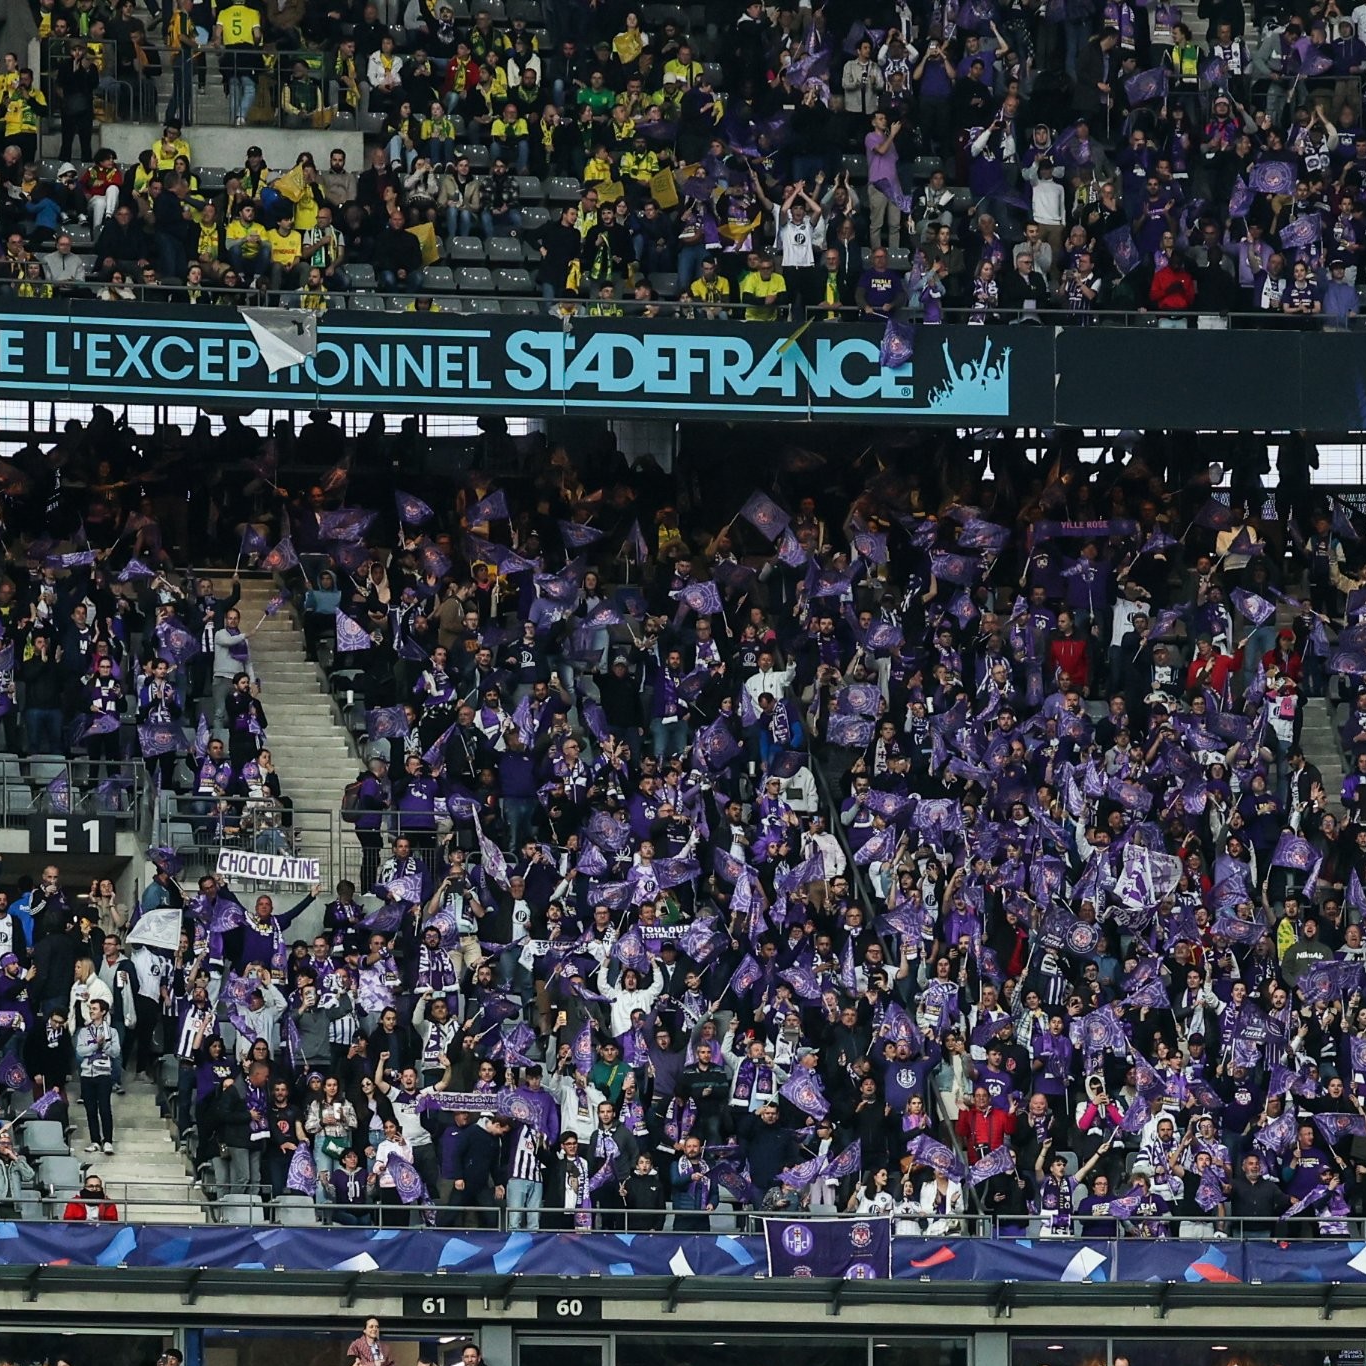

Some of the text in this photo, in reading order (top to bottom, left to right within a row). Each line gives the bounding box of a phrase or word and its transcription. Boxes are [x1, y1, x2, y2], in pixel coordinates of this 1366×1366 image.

[45, 330, 493, 390] L'EXCEPONNEL
[504, 330, 914, 399] STADEFRANCE
[218, 851, 320, 881] CHOCOLATINE
[639, 925, 691, 934] TOULOUS
[788, 1240, 809, 1250] TFC
[421, 1296, 446, 1314] 61
[555, 1299, 583, 1317] 60
